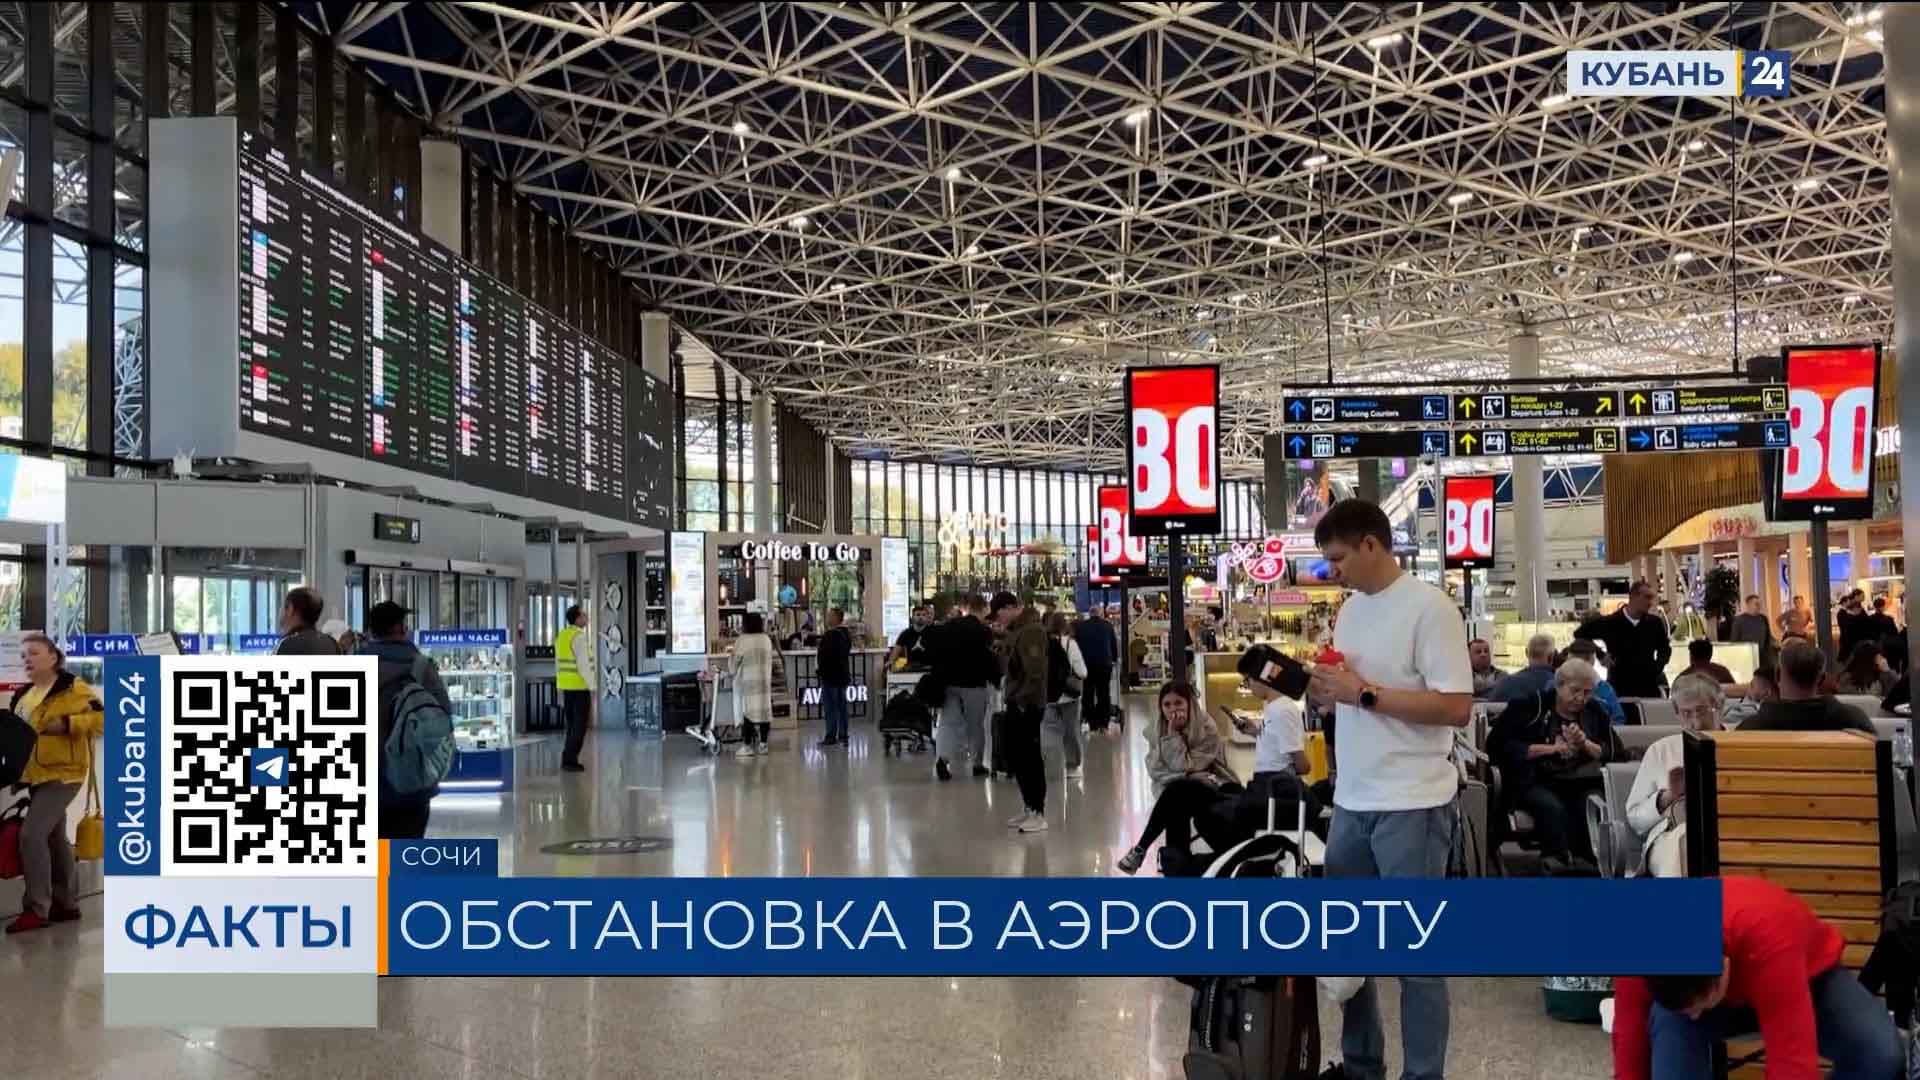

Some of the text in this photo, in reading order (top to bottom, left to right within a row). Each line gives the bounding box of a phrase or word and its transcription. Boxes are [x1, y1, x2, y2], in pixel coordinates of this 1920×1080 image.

[741, 540, 860, 561] Coffee To Go
[424, 633, 500, 642] УМНЫЕ ЧАСЫ
[93, 640, 129, 651] СИМ
